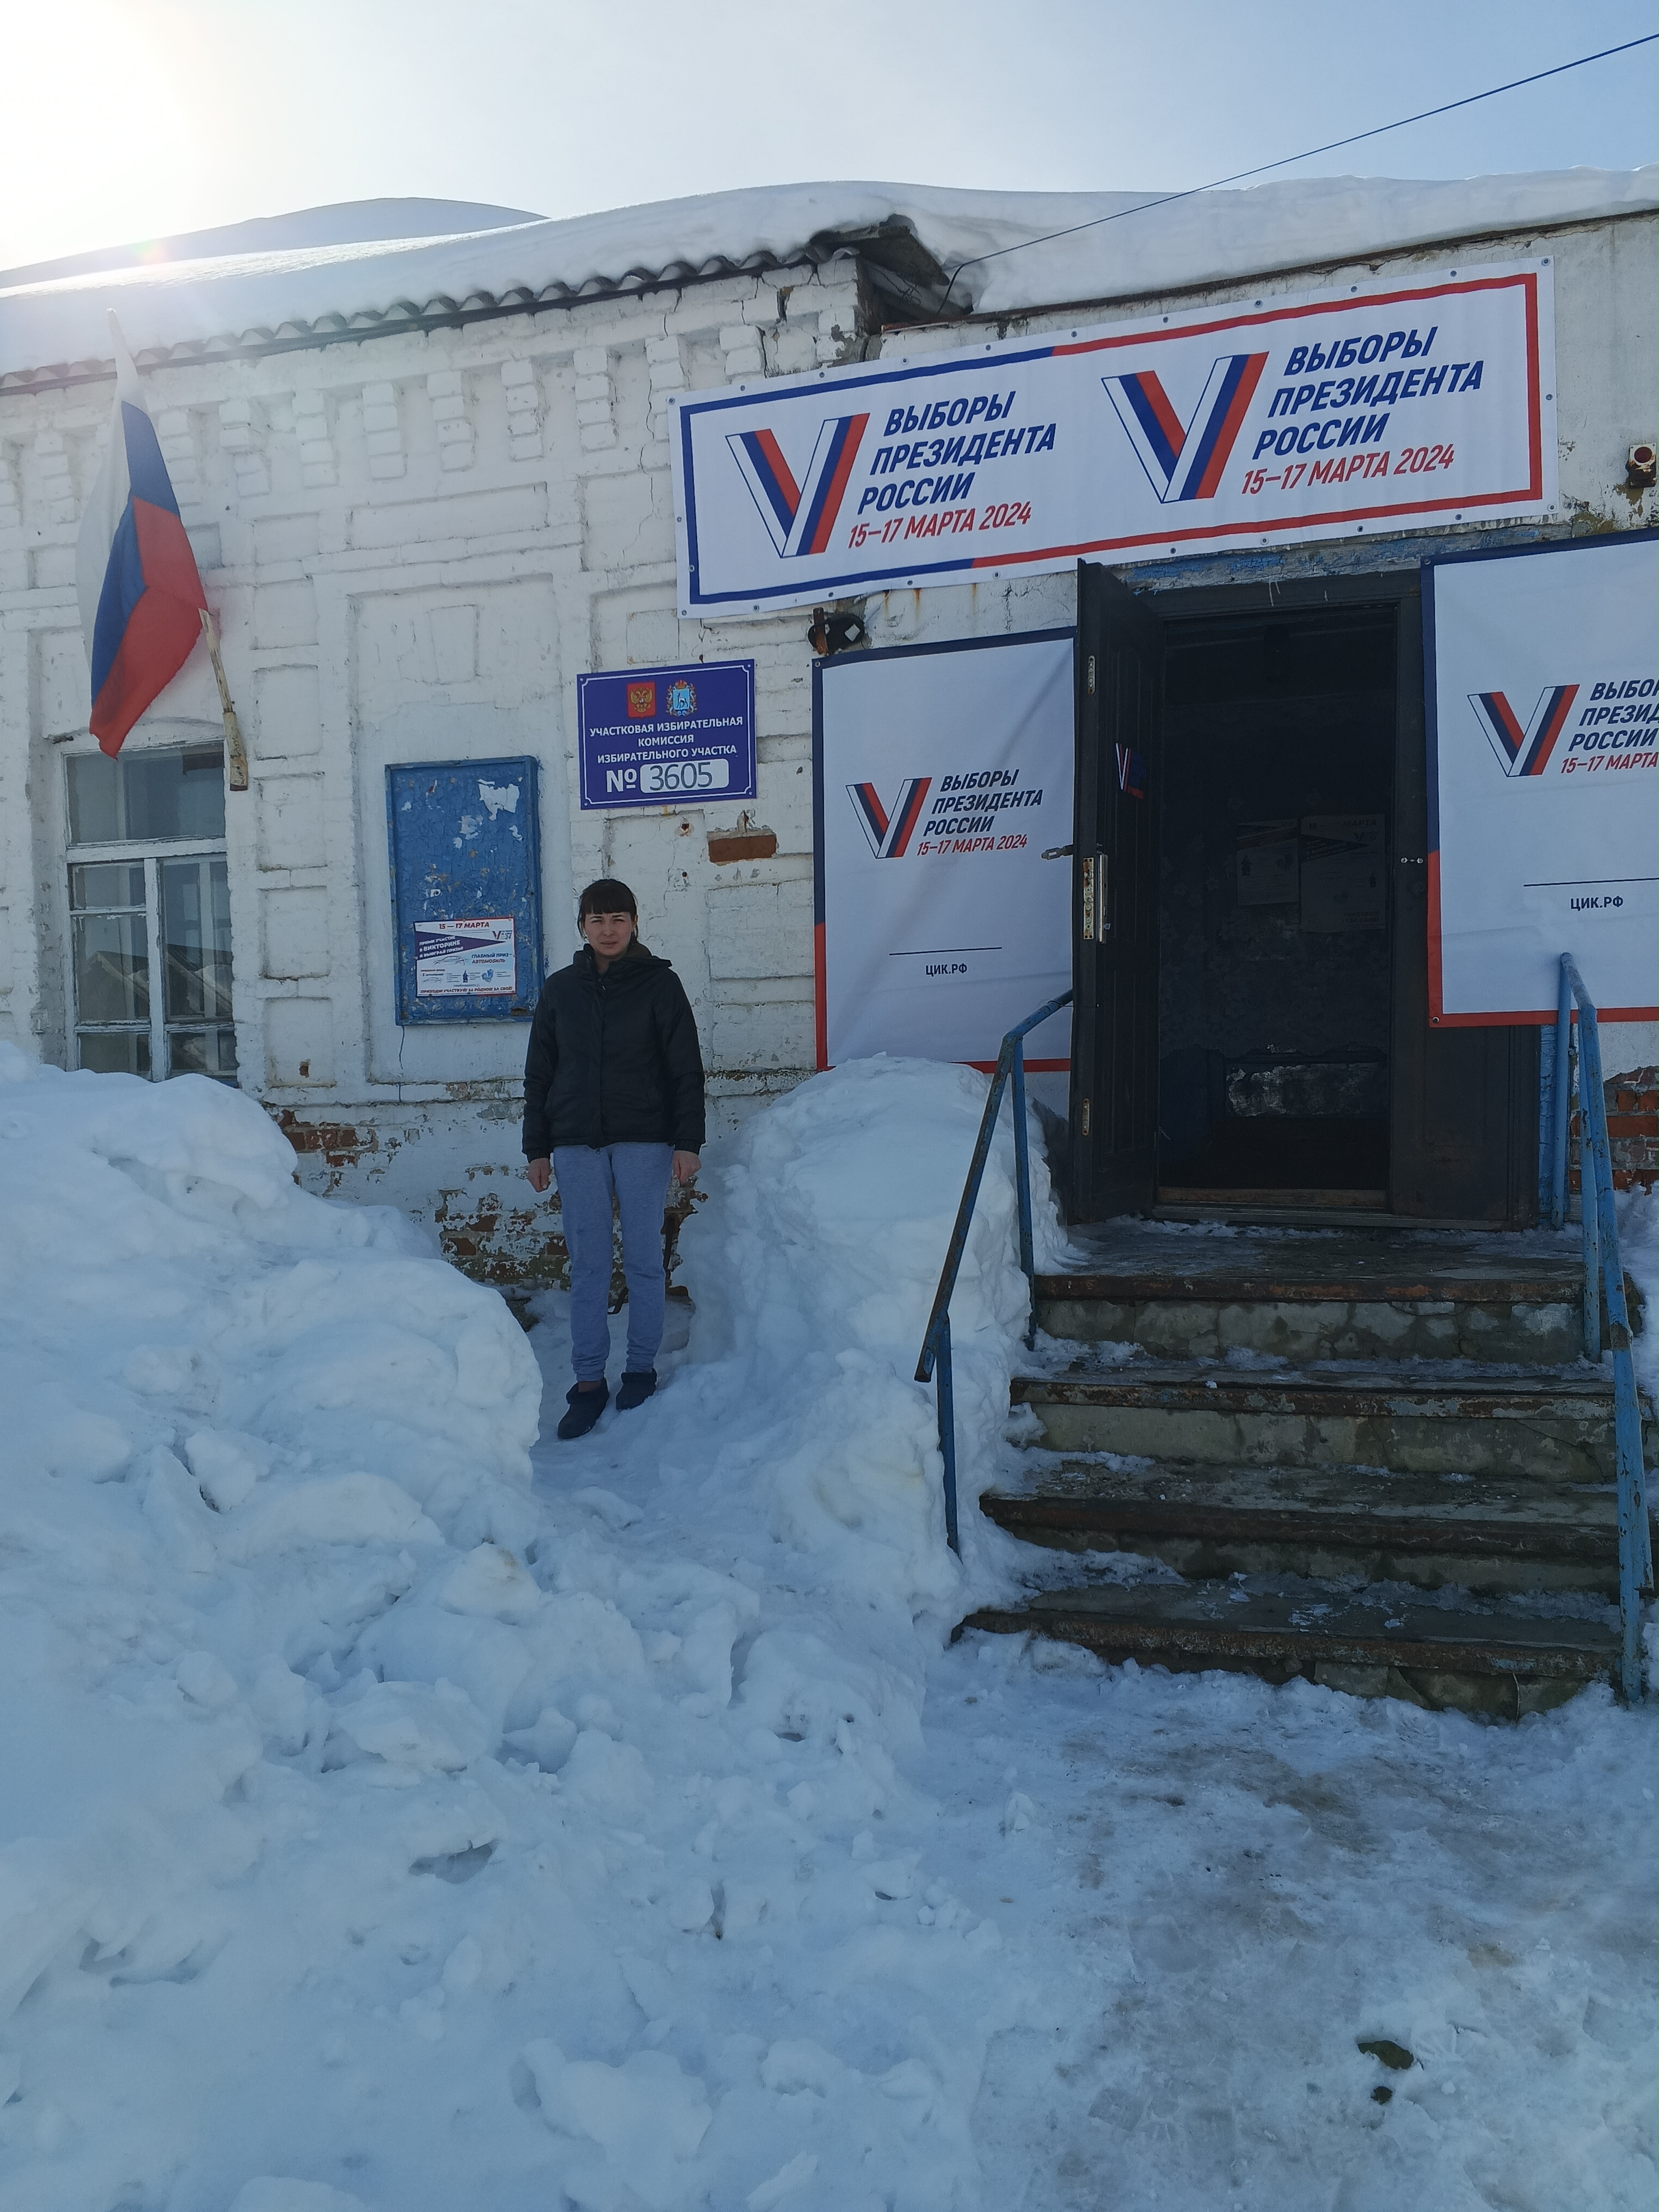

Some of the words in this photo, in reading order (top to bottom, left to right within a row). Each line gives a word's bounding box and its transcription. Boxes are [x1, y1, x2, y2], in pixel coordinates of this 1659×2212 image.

[1283, 327, 1439, 377] ВЫБОРЫ
[1268, 360, 1484, 419] ПРЕЗИДЕНТА
[884, 390, 1016, 438] ВЫБОРЫ
[1252, 413, 1391, 460] РОССИИ
[870, 423, 1056, 476] ПРЕЗИДЕНТА
[1307, 451, 1391, 487] МАРТА
[1394, 443, 1455, 475] 2024
[857, 472, 975, 515] РОССИИ
[904, 508, 976, 541] МАРТА
[979, 501, 1032, 532] 2024
[589, 724, 654, 737] УЧАСТКОВАЯ
[657, 716, 743, 732] ИЗБИРАТЕЛЬНАЯ
[638, 734, 695, 747] КОМИССИЯ
[1568, 728, 1659, 752] РОССИИ
[598, 749, 689, 764] ИЗБИРАТЕЛЬНОГО
[691, 745, 737, 757] УЧАСТКА
[1605, 752, 1659, 771] МАРТА
[649, 761, 713, 791] 3605
[939, 769, 1019, 792] ВЫБОРЫ
[931, 789, 1043, 815] ПРЕЗИДЕНТА
[923, 816, 995, 837] РОССИИ
[951, 837, 994, 853] МАРТА
[997, 834, 1028, 850] 2024
[1570, 896, 1624, 911] ЦИК.РФ
[423, 940, 460, 952] ВИКТОРИНЕ
[423, 949, 446, 957] ВЫИГРАЙ
[925, 963, 967, 977] ЦИК.РФ
